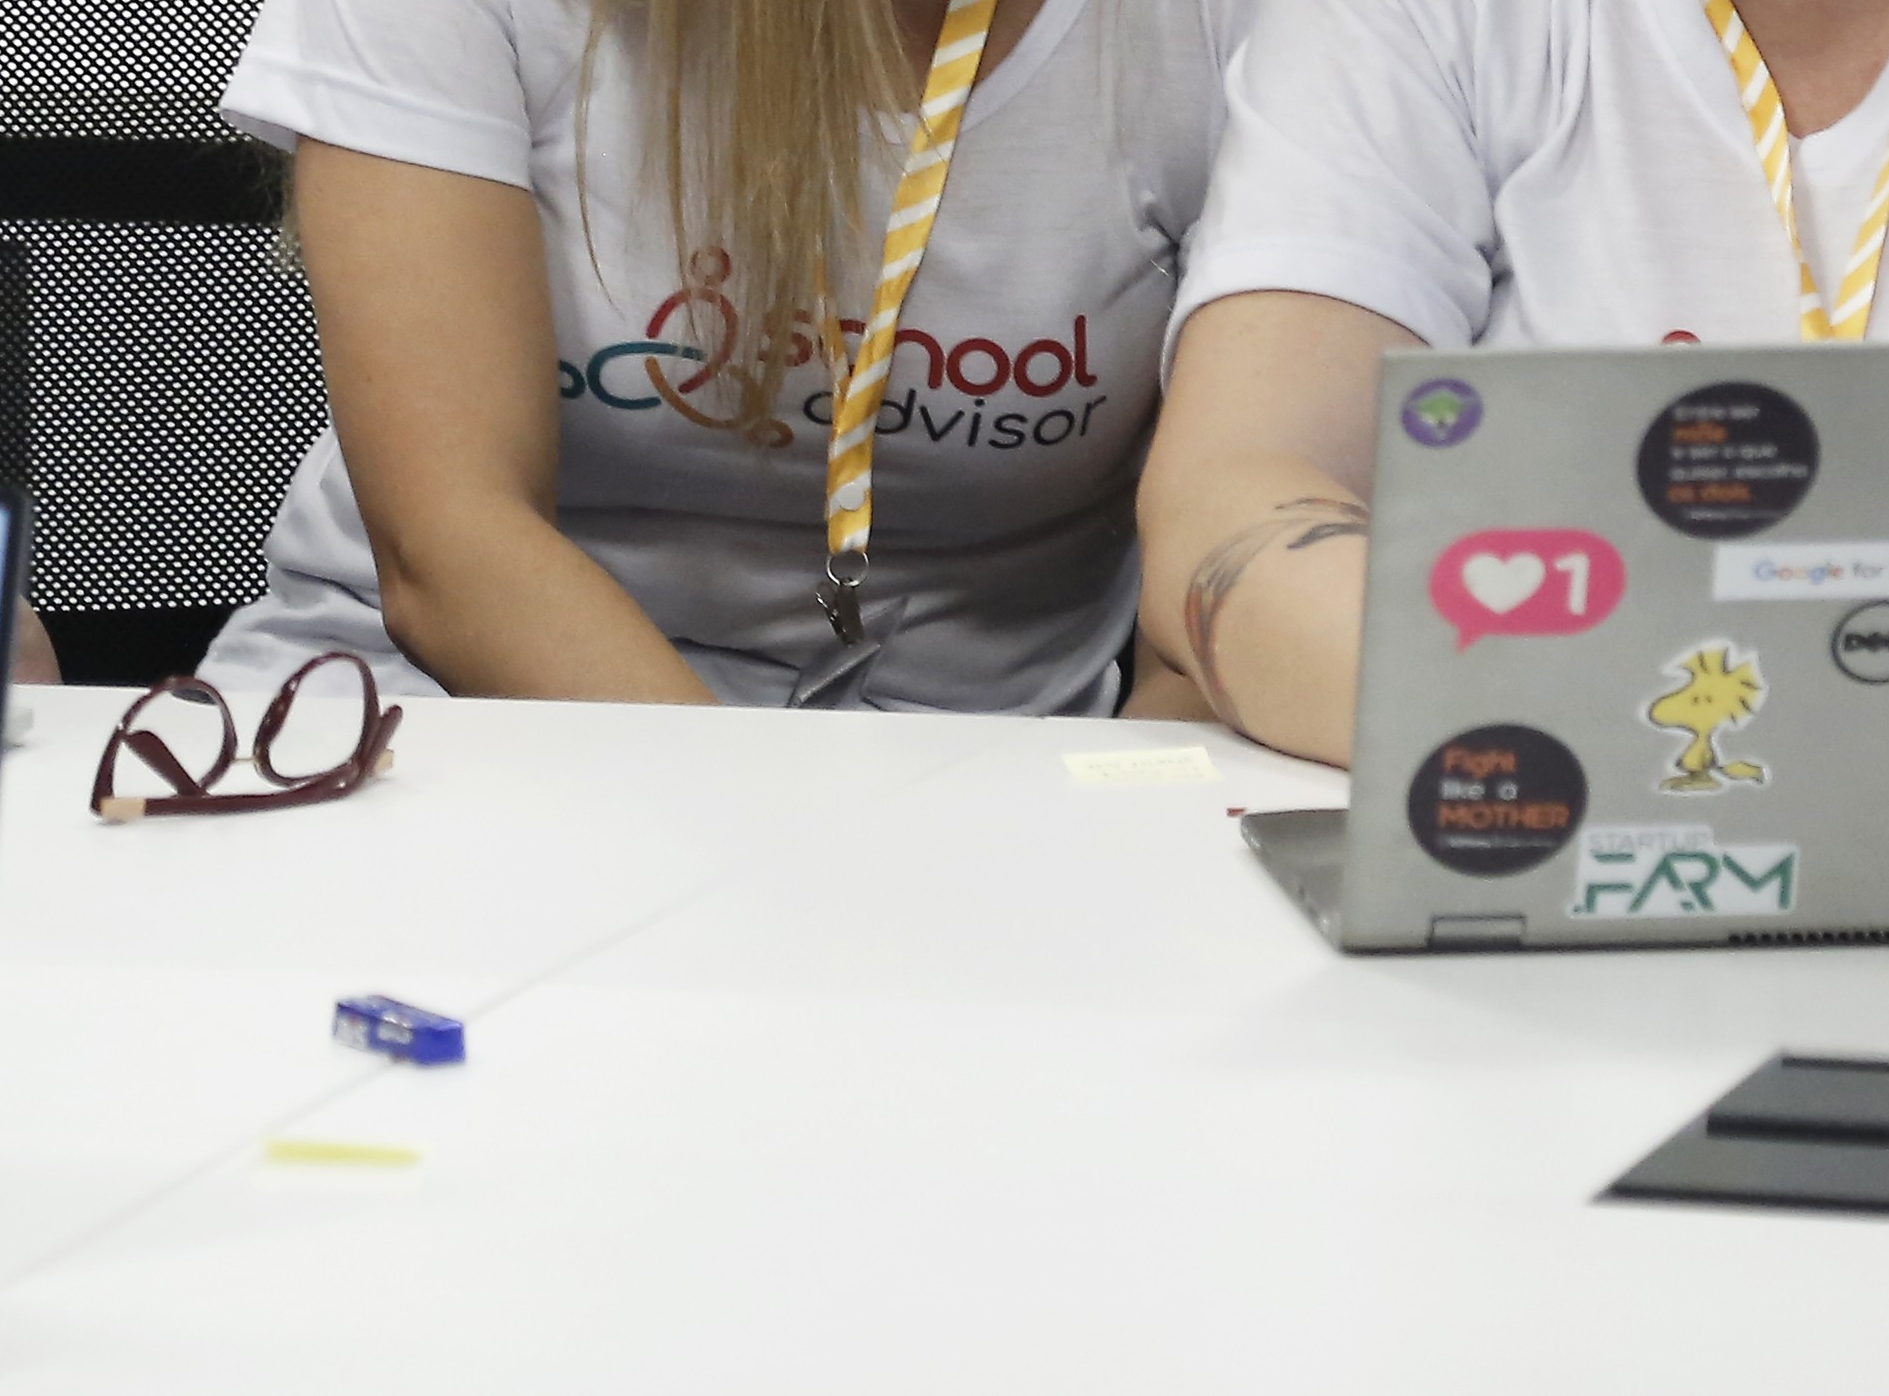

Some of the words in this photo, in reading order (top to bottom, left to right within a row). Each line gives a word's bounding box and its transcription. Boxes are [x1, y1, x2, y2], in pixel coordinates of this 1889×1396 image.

[1555, 553, 1589, 616] 1
[1752, 559, 1844, 585] Google
[1852, 561, 1884, 579] for
[1443, 746, 1518, 779] Fight
[1441, 778, 1485, 800] like
[1438, 803, 1571, 830] MOTHER
[1589, 833, 1709, 851] STARTUP
[1573, 851, 1795, 912] FARM
